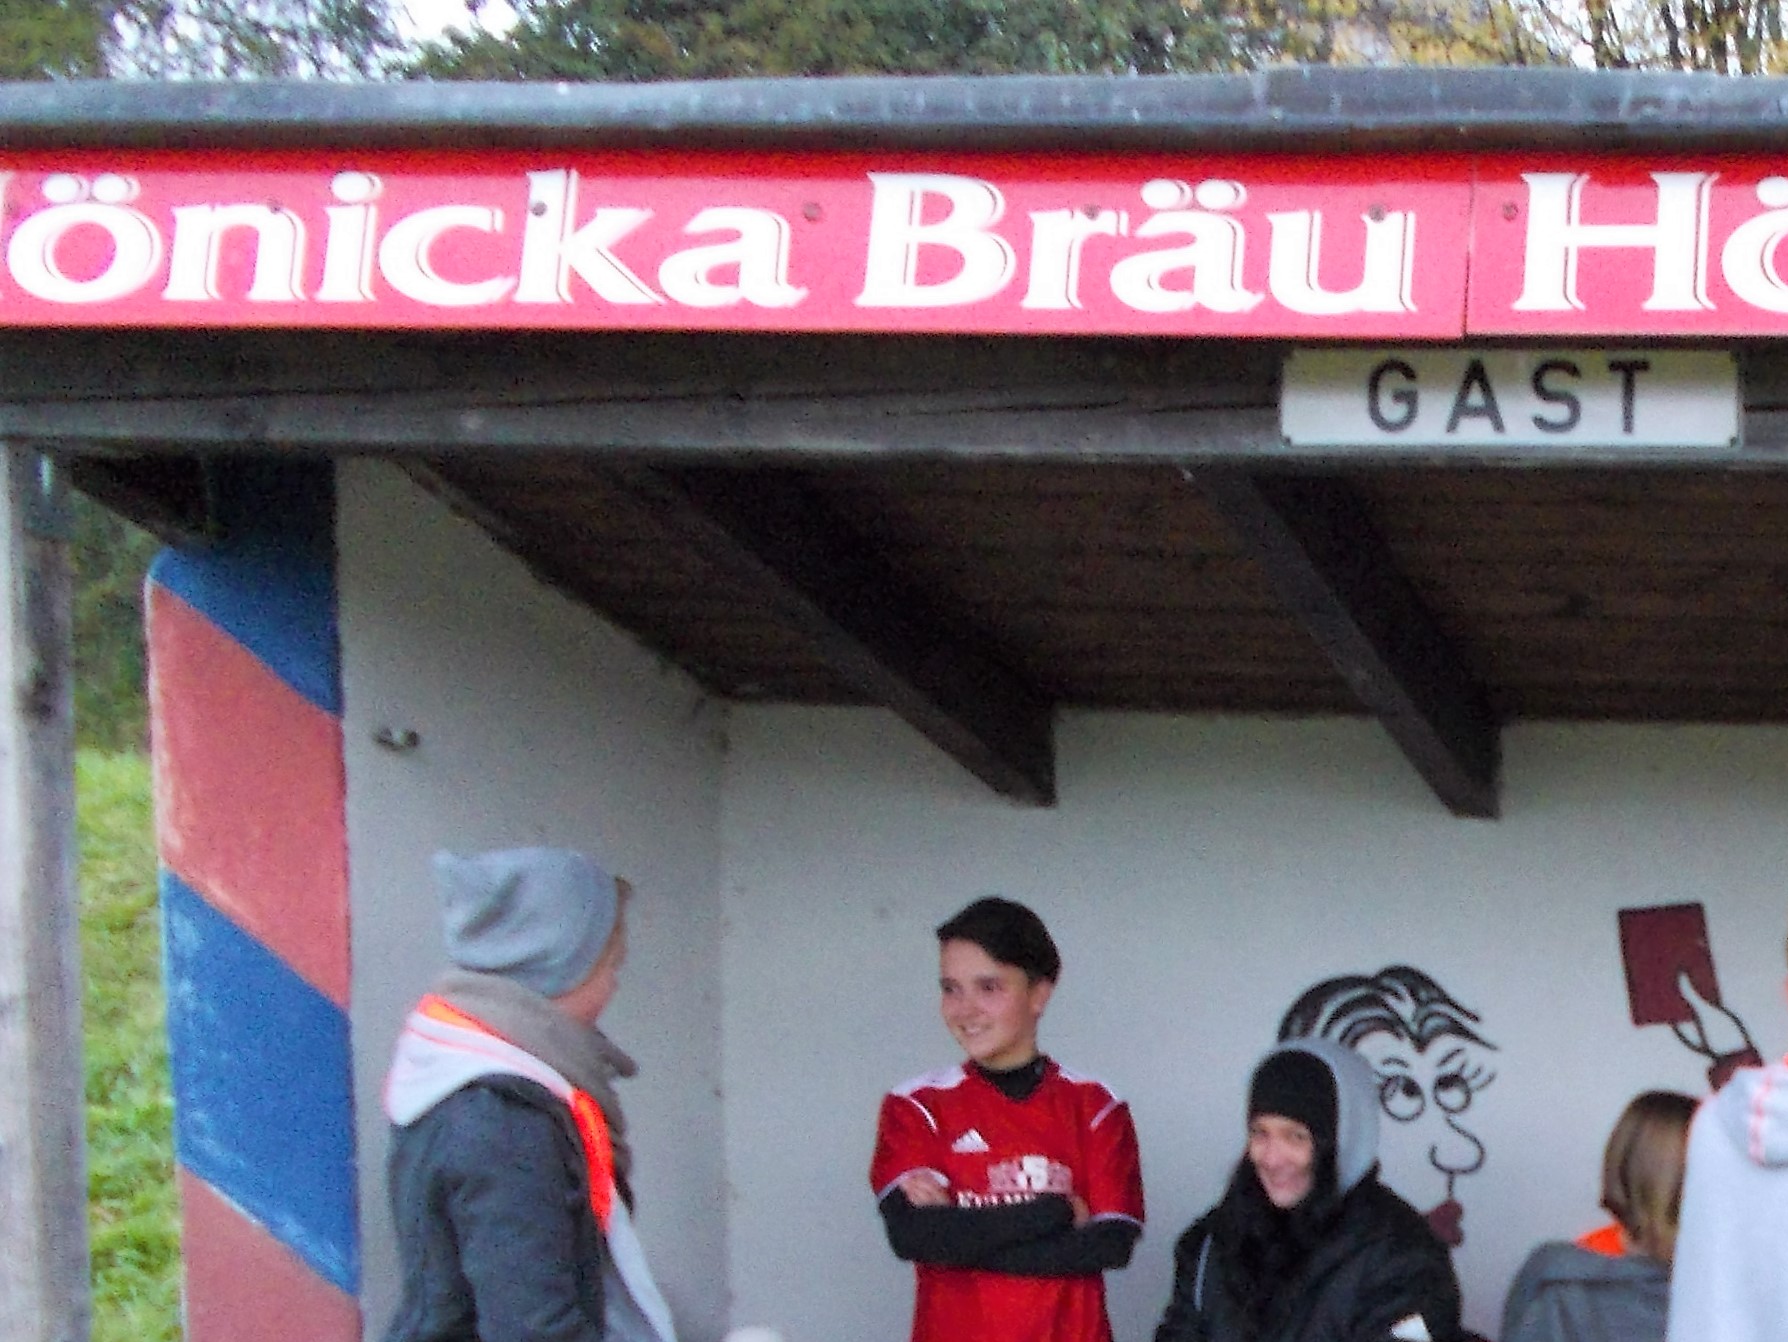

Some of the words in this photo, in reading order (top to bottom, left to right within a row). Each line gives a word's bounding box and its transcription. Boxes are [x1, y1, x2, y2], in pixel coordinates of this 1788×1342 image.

[0, 168, 808, 307] önicka
[854, 171, 1419, 314] Bräu
[1367, 358, 1652, 435] GAST
